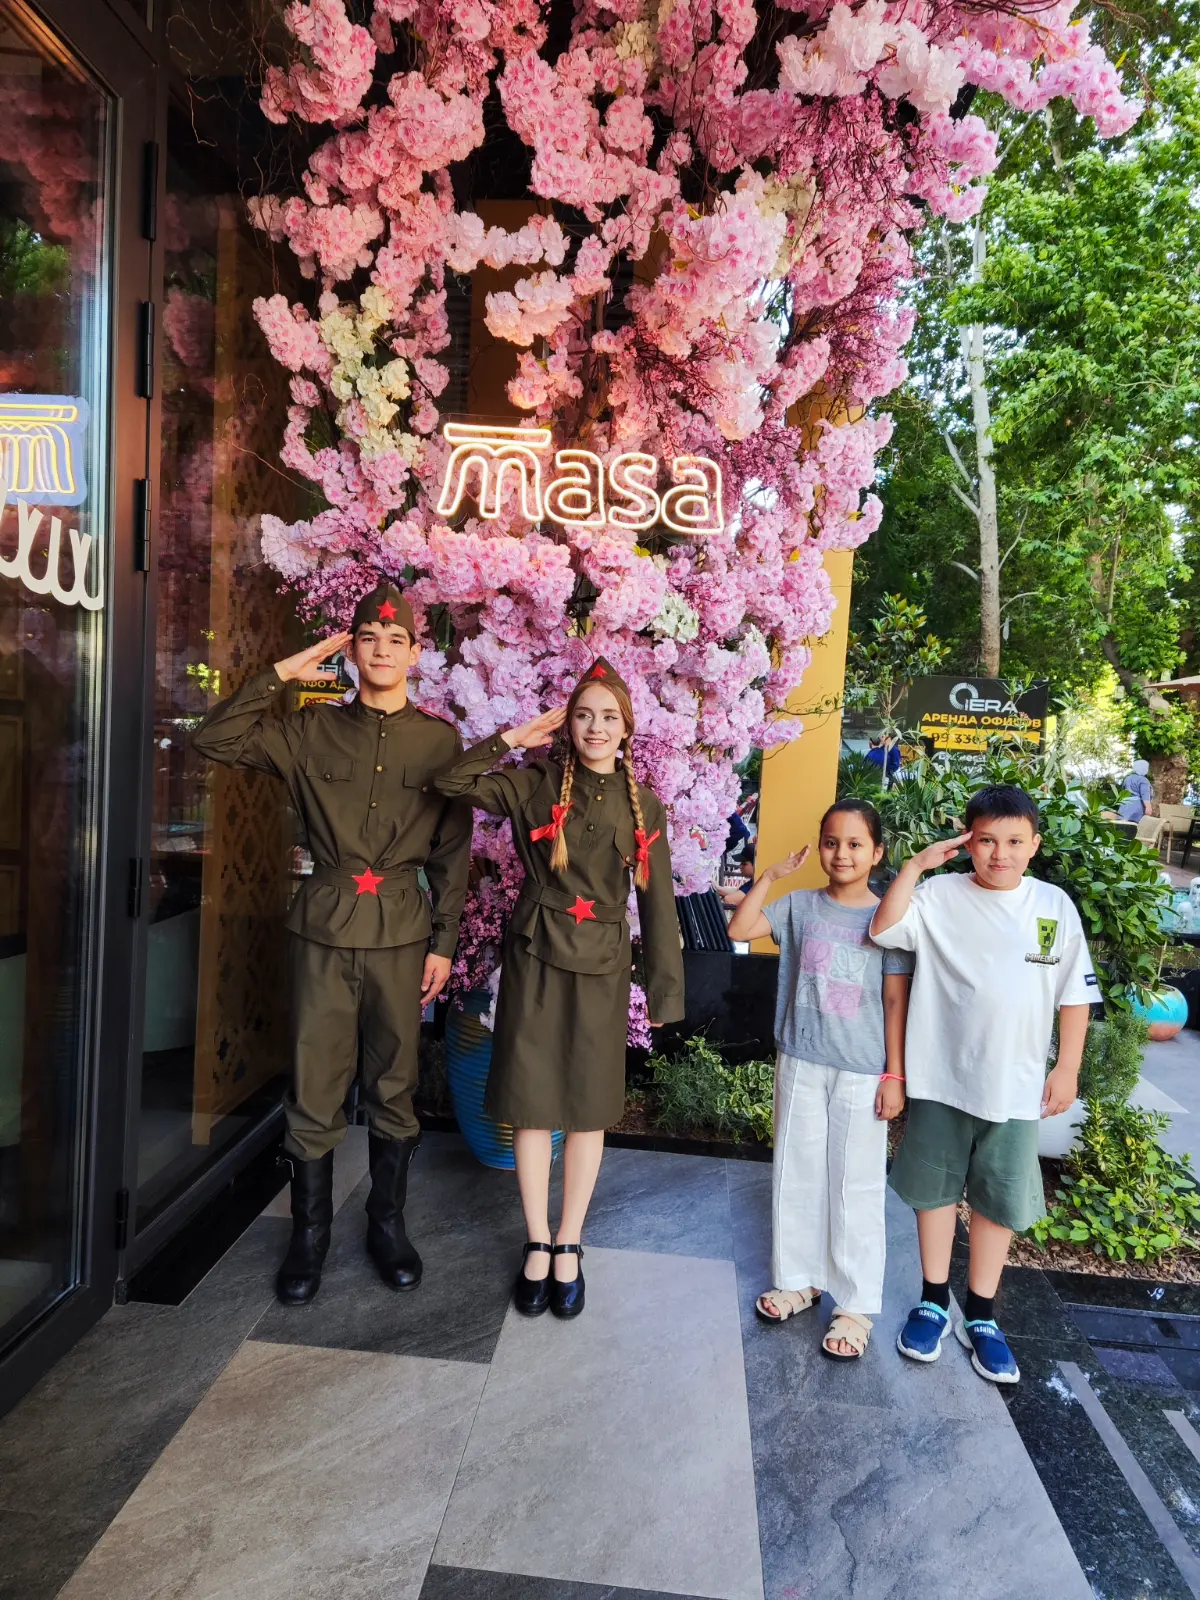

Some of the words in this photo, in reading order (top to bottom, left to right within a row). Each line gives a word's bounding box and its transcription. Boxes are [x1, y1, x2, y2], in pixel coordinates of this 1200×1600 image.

[922, 713, 977, 725] АРЕНДА
[918, 1309, 940, 1320] FASHION
[973, 1325, 996, 1336] FASHION
